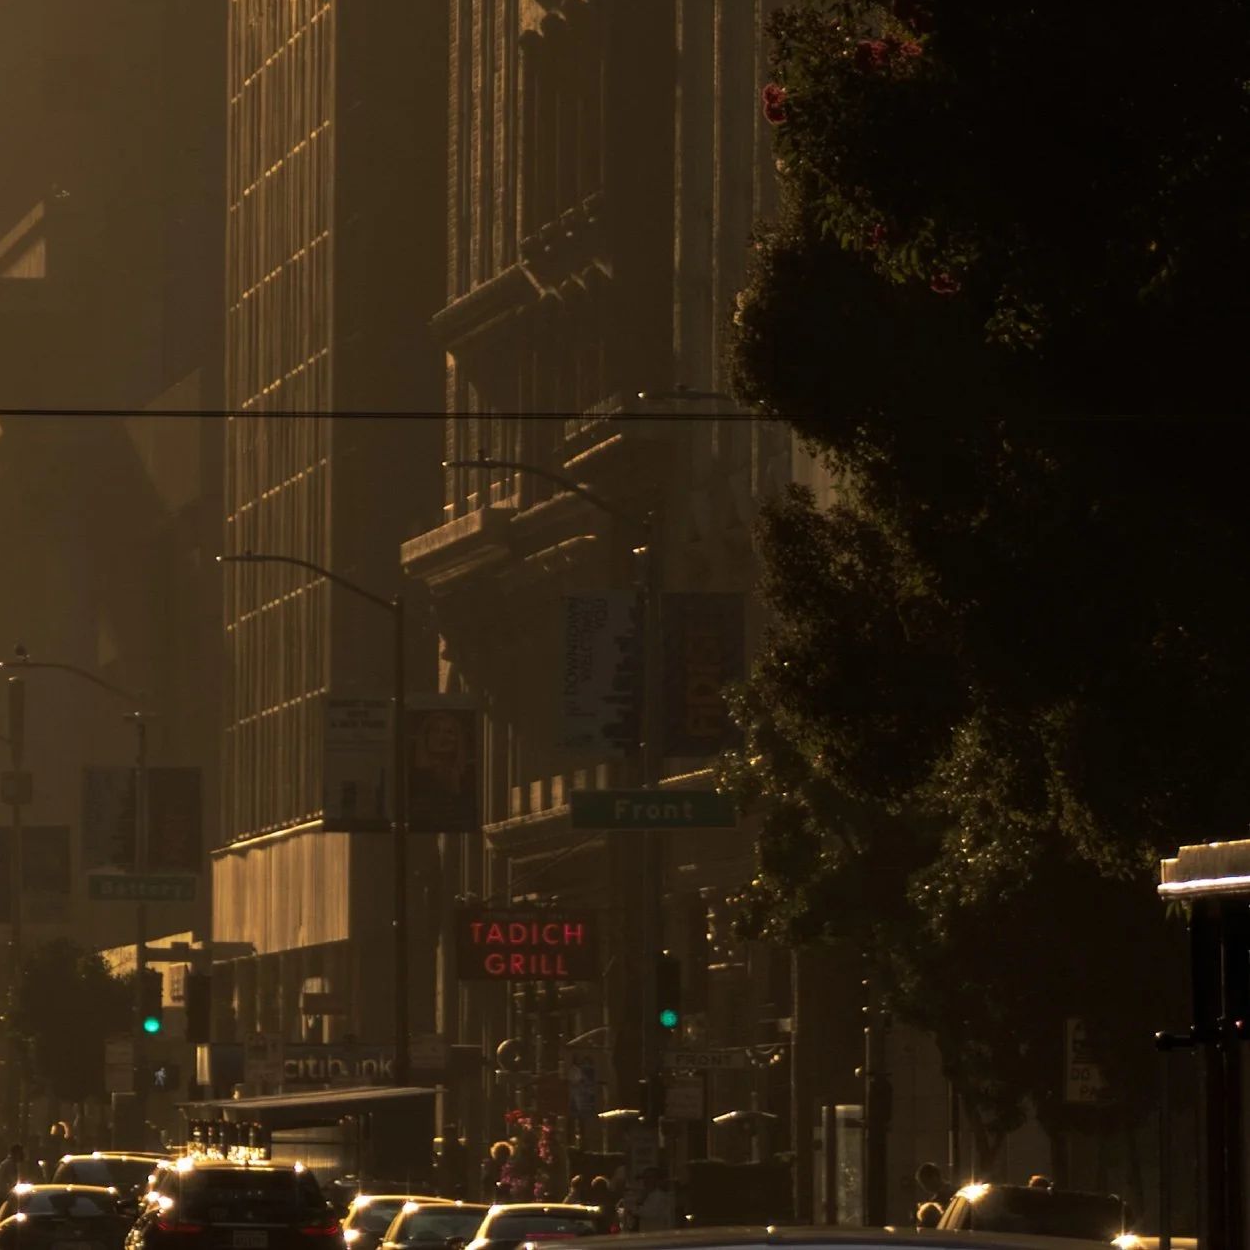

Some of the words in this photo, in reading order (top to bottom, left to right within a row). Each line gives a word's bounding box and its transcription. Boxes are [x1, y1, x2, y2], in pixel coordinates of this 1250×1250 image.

[615, 799, 694, 821] Front
[470, 922, 584, 945] TADICH
[484, 953, 569, 976] GRILL
[675, 1054, 732, 1066] FRONT
